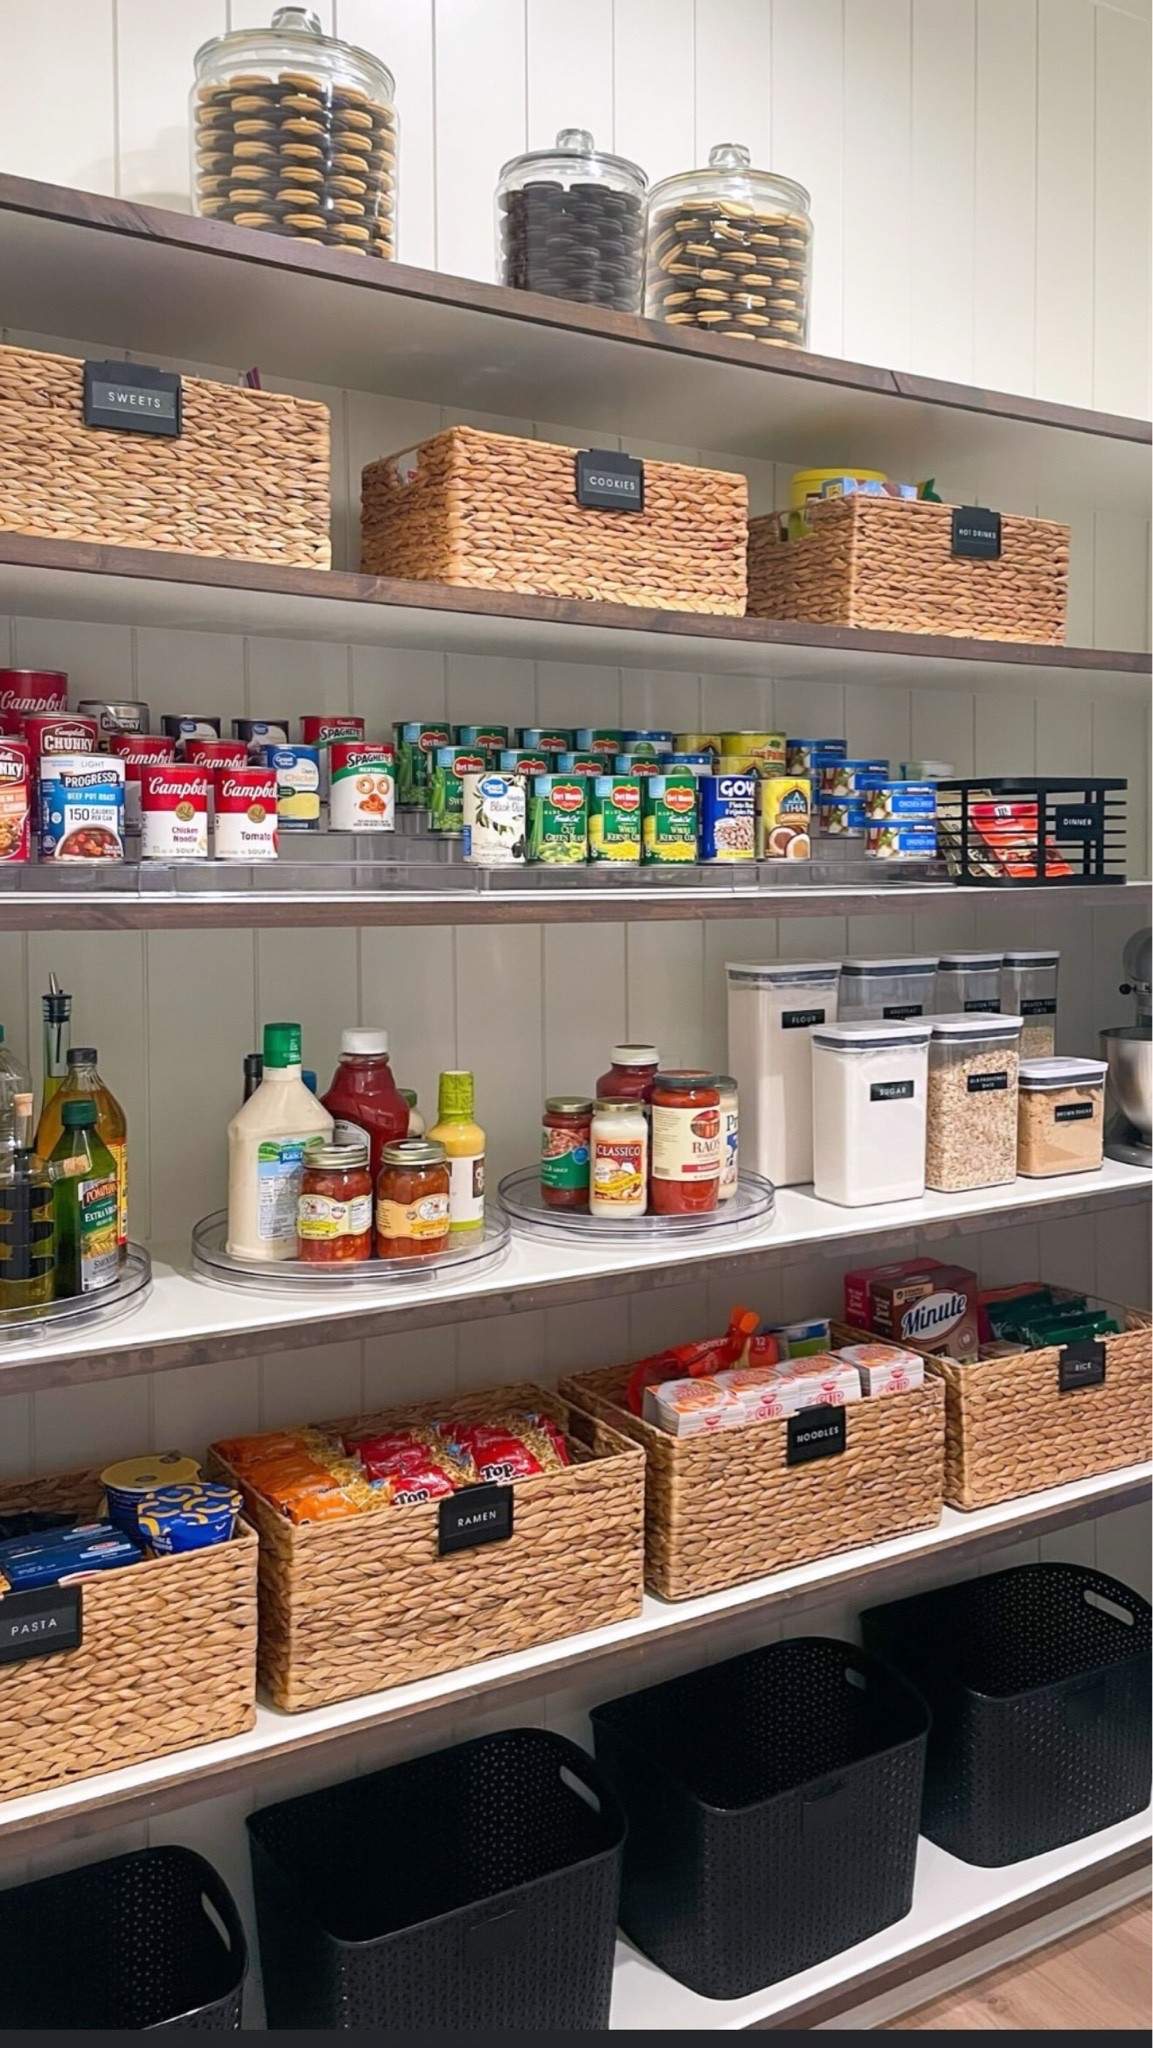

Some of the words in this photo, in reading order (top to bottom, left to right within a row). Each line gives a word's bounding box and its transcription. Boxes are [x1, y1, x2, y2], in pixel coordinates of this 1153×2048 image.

[108, 391, 161, 408] SWEETS
[589, 476, 635, 490] COOKIES
[972, 530, 996, 539] DRINKS
[44, 735, 94, 753] CHUNKY
[65, 772, 117, 787] PROGRESSO
[69, 808, 90, 821] 150
[1063, 818, 1092, 826] DINNER
[240, 831, 271, 841] Tomato
[791, 1016, 817, 1024] FLOUR
[879, 1087, 907, 1096] SUGAR
[597, 1145, 641, 1156] CLASSICO
[84, 1210, 104, 1223] EXTRA
[903, 1294, 966, 1336] Minute
[755, 1337, 766, 1346] 12
[1075, 1361, 1092, 1371] RICE
[887, 1378, 909, 1393] CUP
[755, 1404, 782, 1420] CUP
[797, 1426, 840, 1443] NOODLES
[481, 1463, 514, 1481] Top
[395, 1489, 428, 1504] Top
[457, 1510, 497, 1527] RAMEN
[11, 1617, 58, 1636] PASTA
